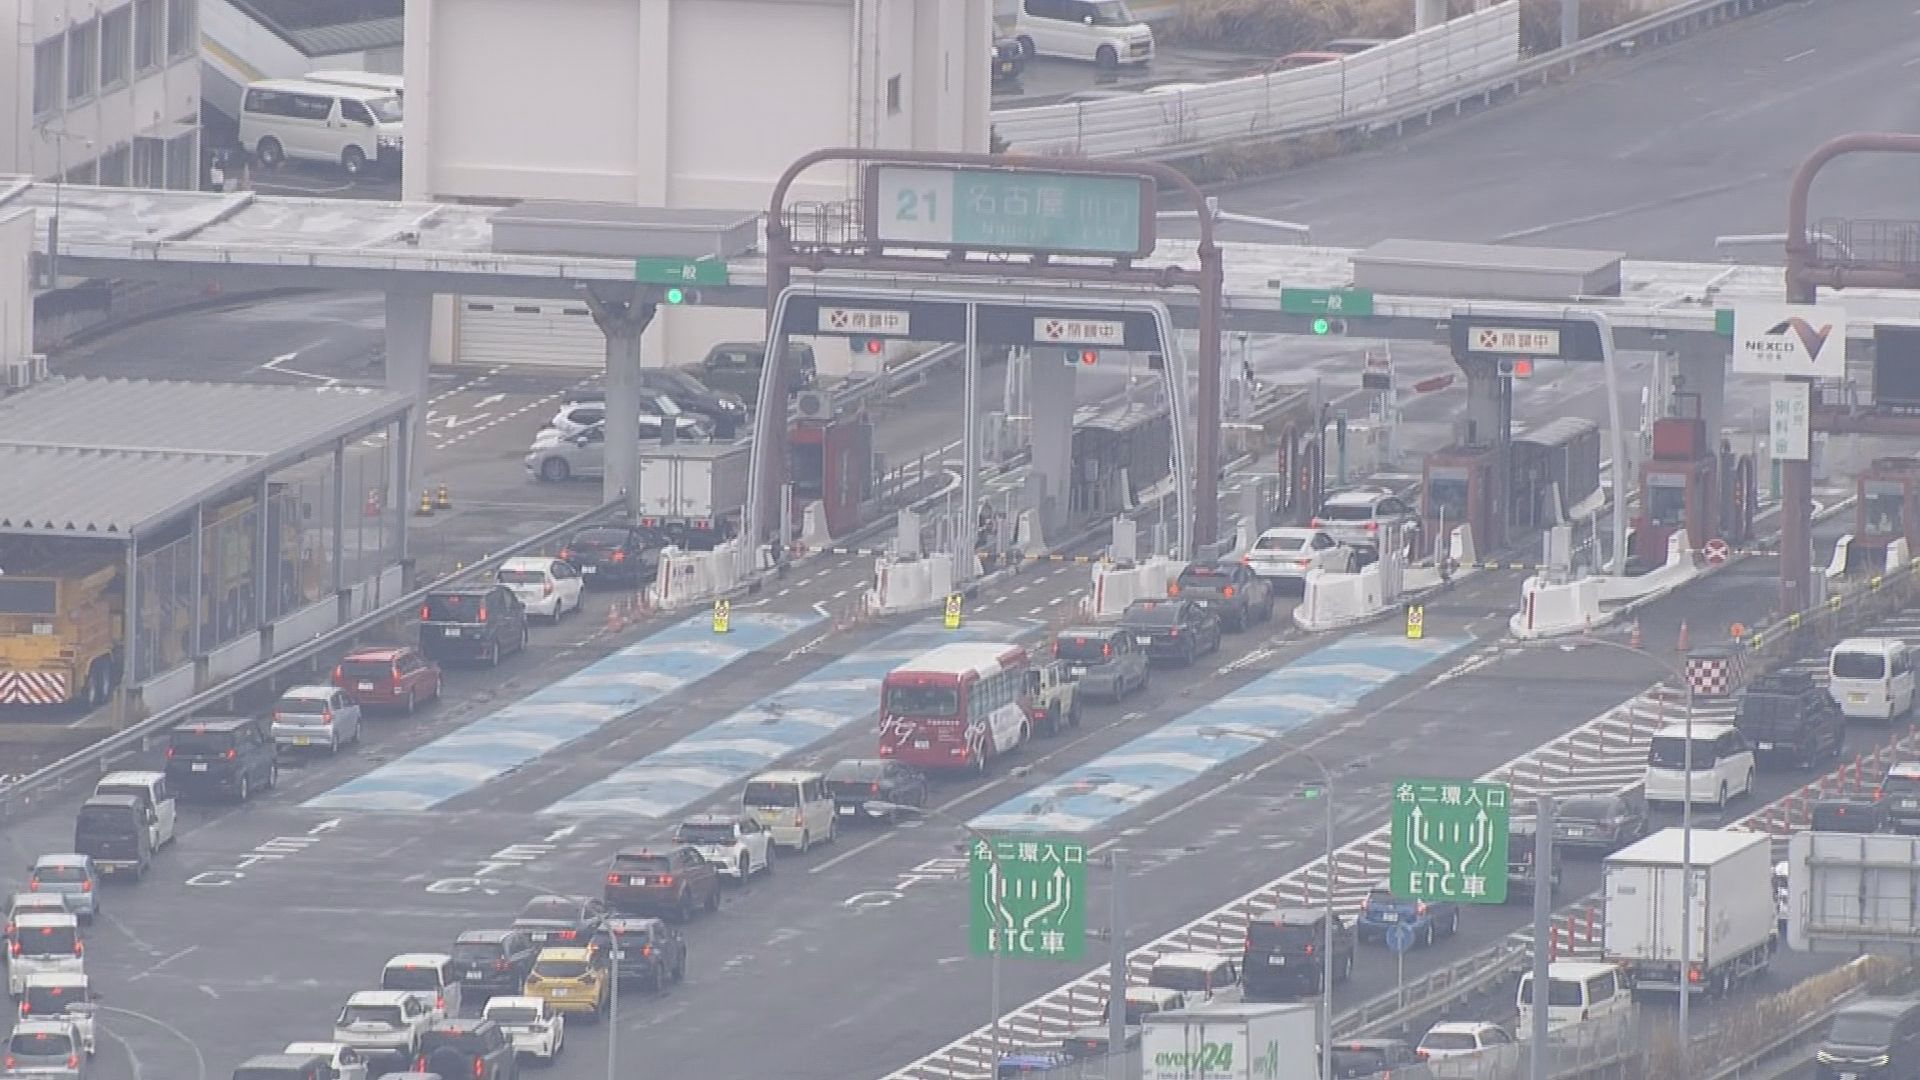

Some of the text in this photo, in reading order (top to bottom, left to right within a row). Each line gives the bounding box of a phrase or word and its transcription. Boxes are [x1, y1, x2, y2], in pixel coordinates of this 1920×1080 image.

[896, 189, 937, 223] 21
[969, 185, 1065, 218] 名古屋
[1745, 340, 1795, 351] NEXCO
[1396, 782, 1505, 808] 名二環入口
[974, 840, 1083, 863] 名二環入口
[1154, 1042, 1233, 1072] every24
